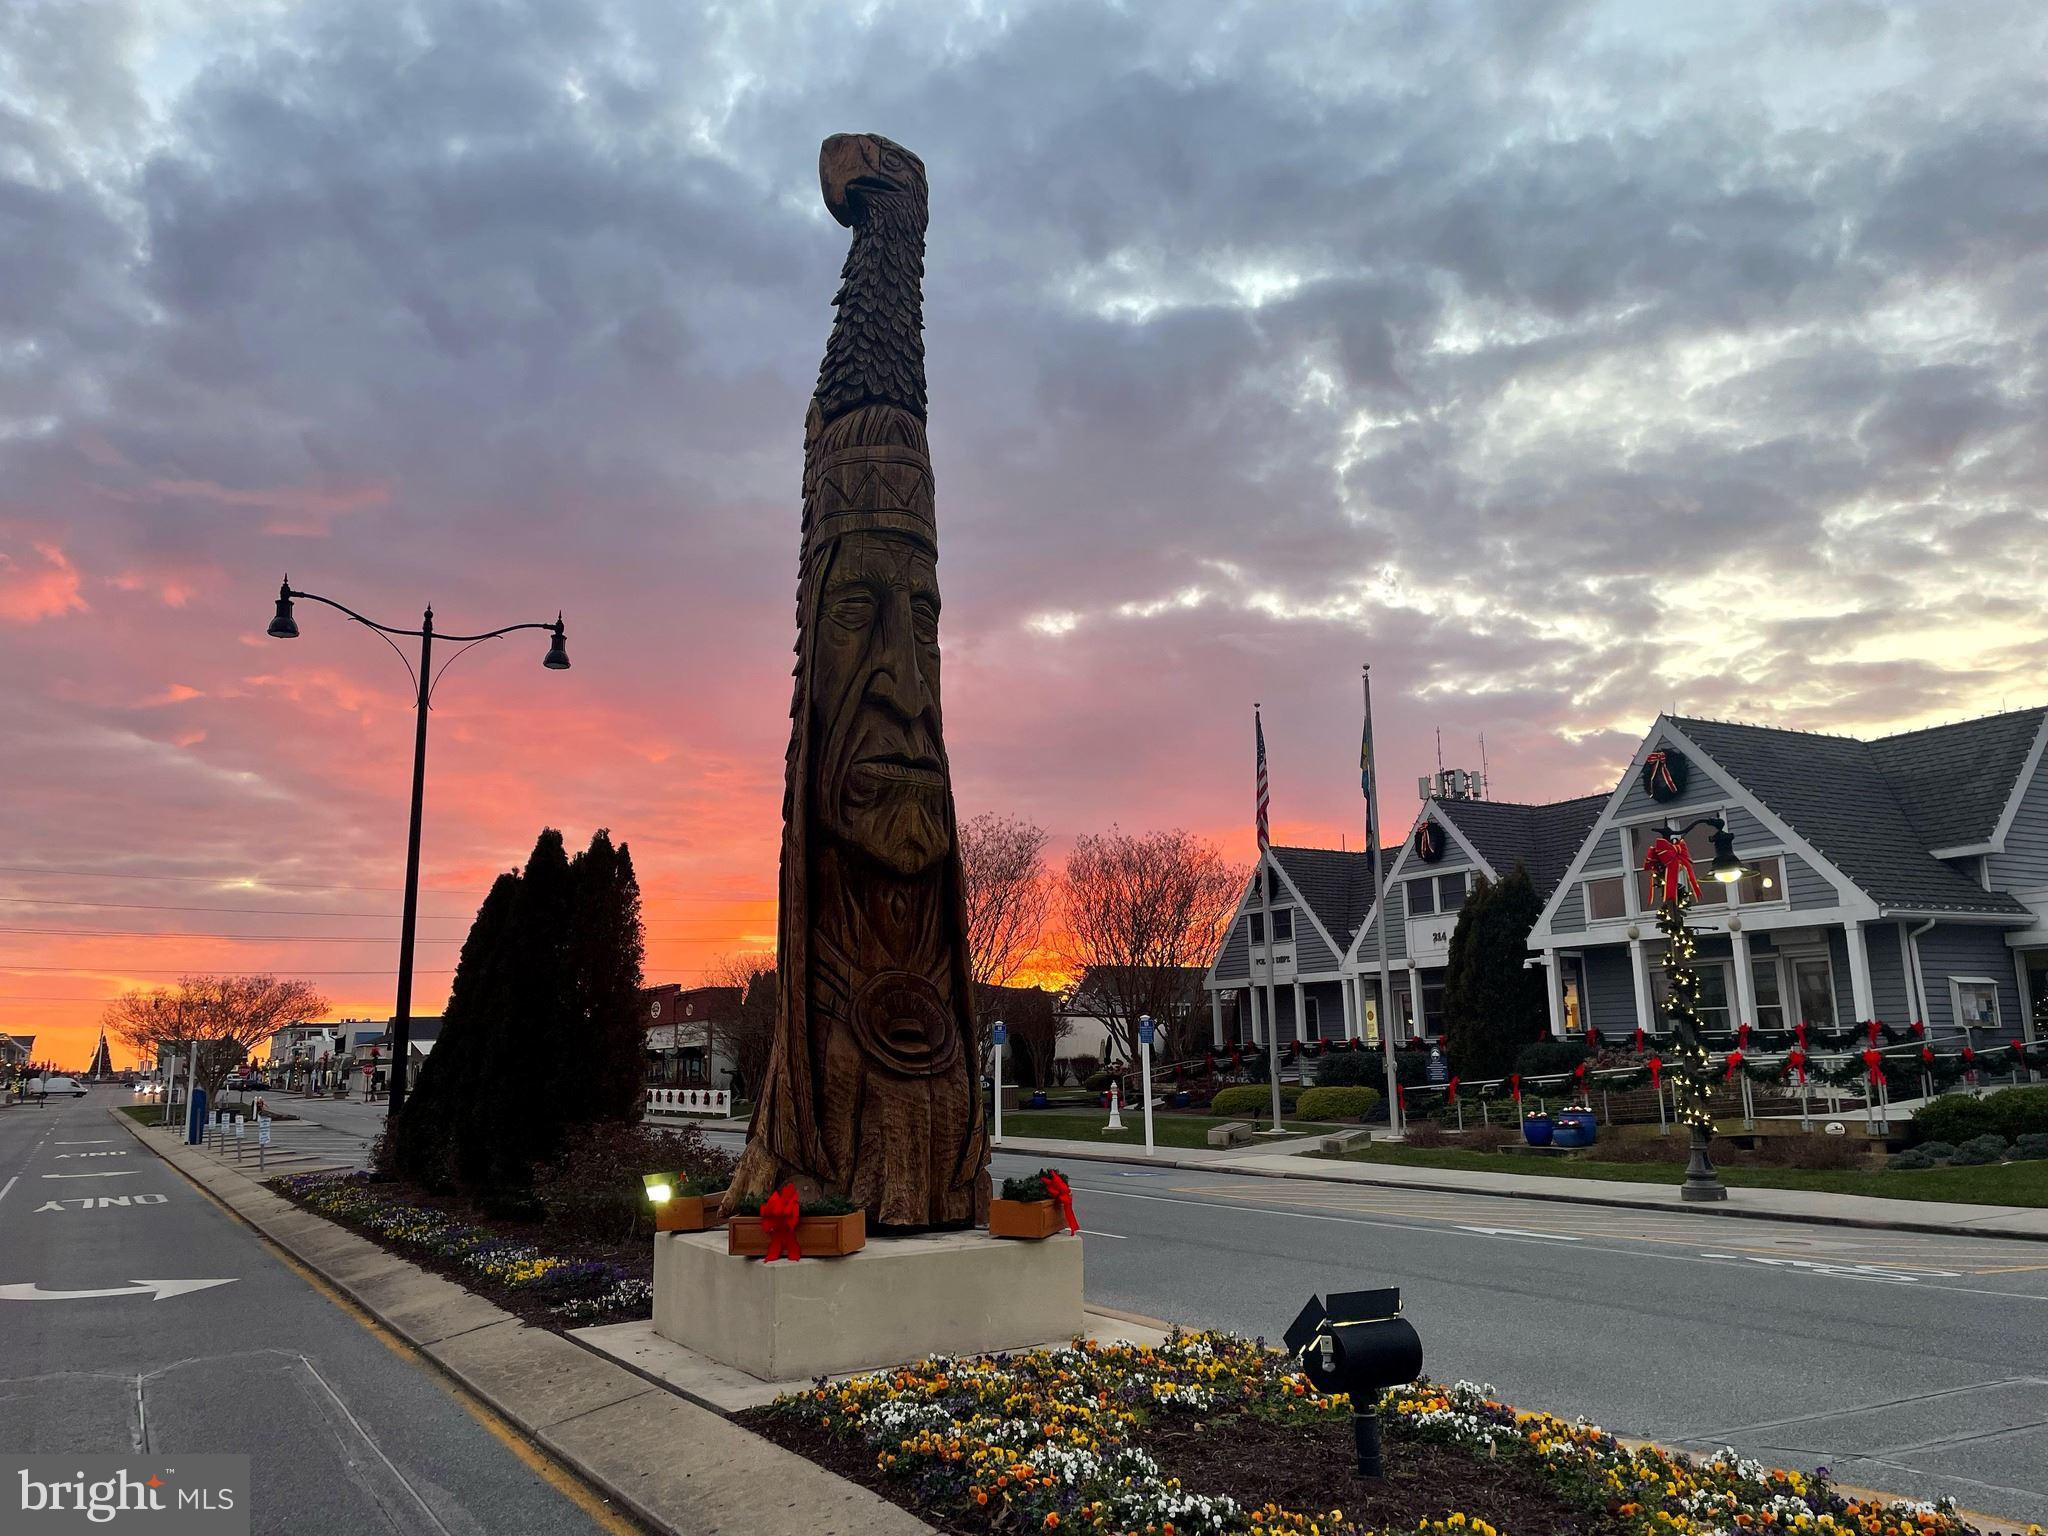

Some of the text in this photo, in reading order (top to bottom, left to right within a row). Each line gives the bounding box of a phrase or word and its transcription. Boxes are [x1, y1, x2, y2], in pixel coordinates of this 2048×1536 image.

[1433, 931, 1447, 942] 214
[55, 1151, 127, 1159] ONLY
[32, 1194, 169, 1213] ONLY
